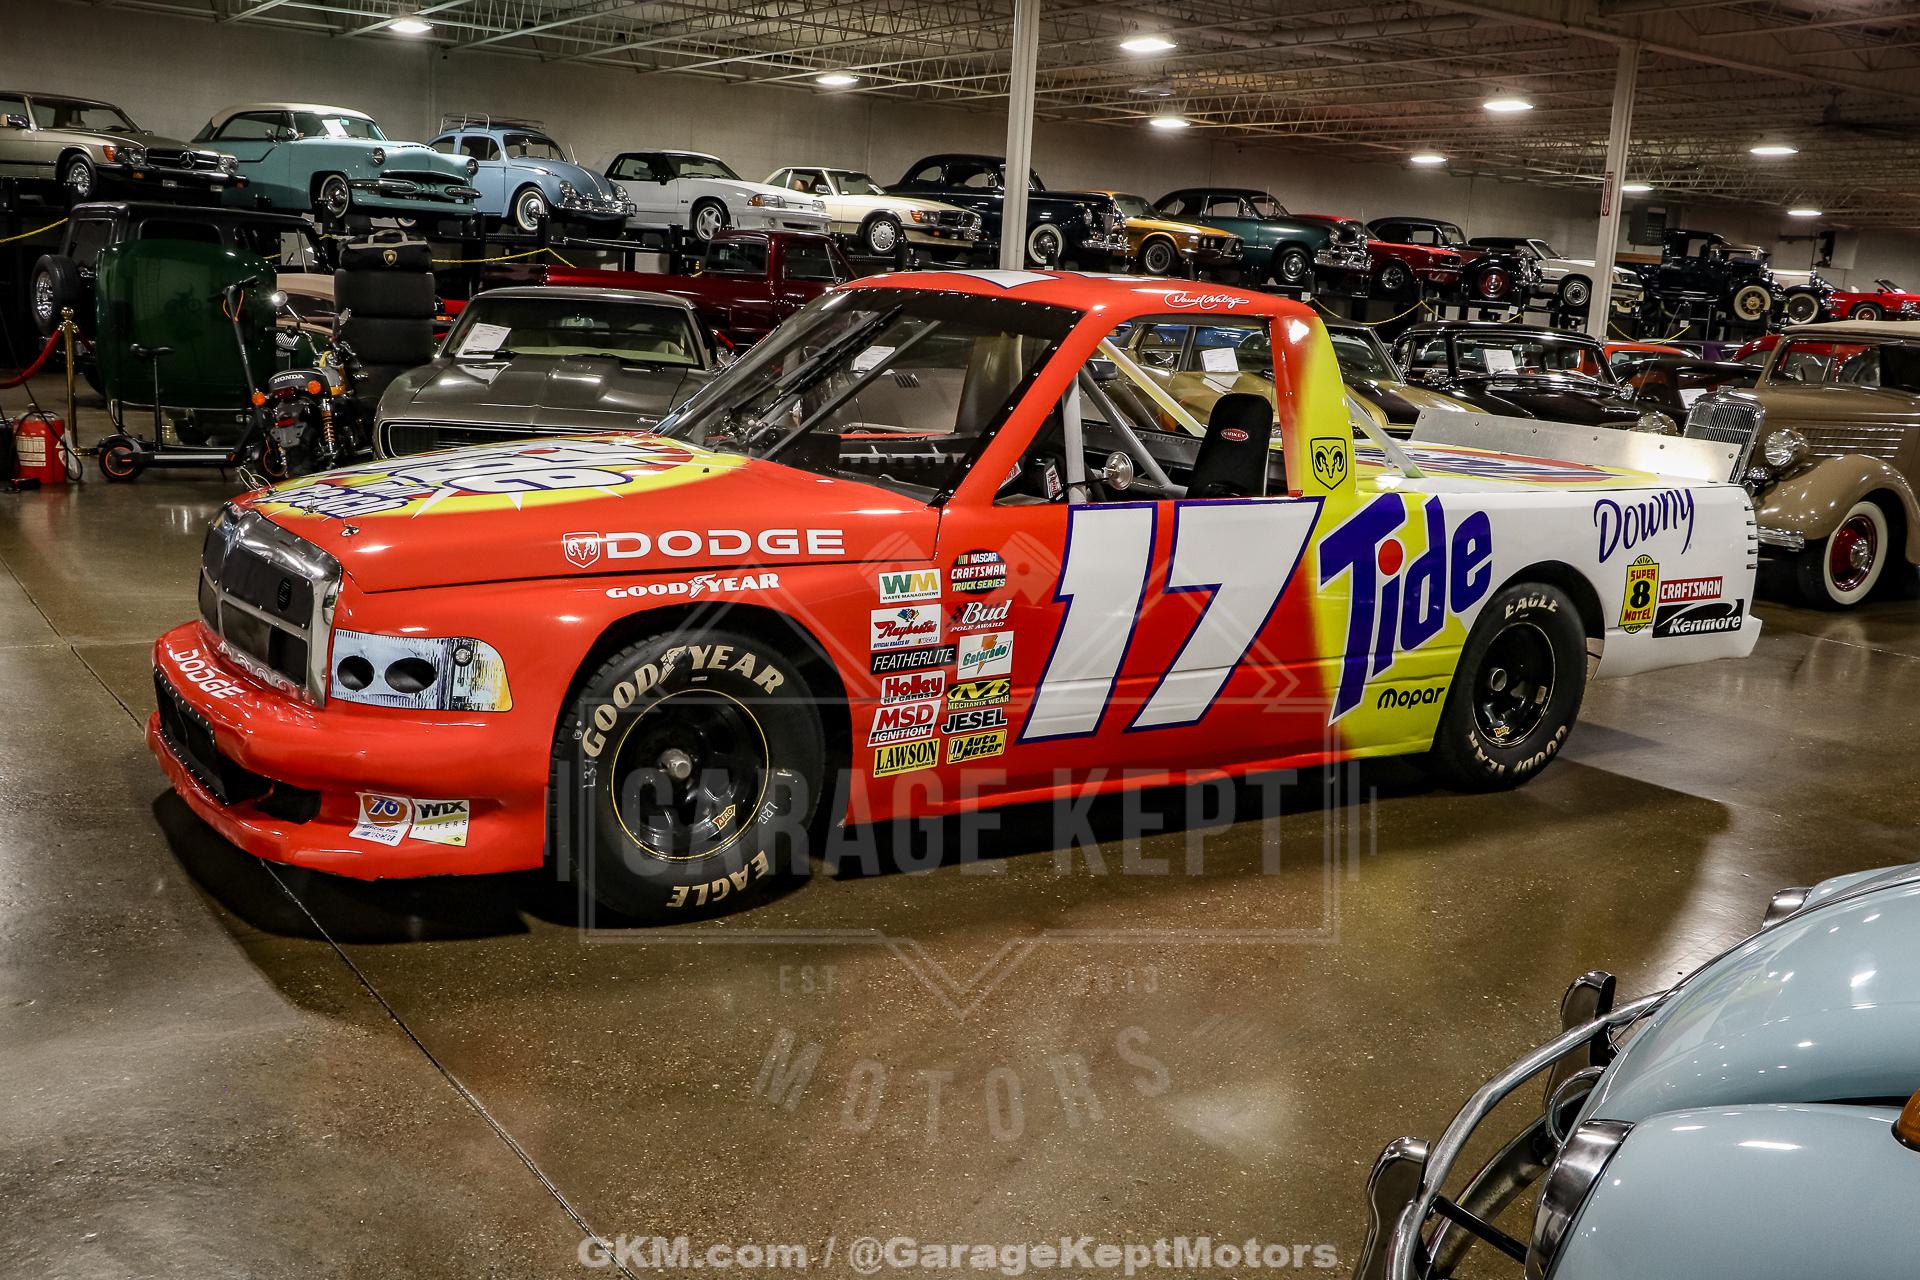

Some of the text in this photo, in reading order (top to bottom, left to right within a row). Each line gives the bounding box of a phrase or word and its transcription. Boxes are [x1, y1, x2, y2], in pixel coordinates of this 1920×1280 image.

[274, 374, 305, 384] HONDA
[1593, 488, 1695, 563] Downy
[604, 528, 846, 560] DODGE
[970, 552, 997, 564] NASCAR
[951, 564, 1007, 580] CRAFTSMAN
[1630, 568, 1656, 582] SUPER
[881, 572, 938, 595] WM
[951, 578, 1006, 592] TRUCK SERIES
[1661, 580, 1721, 600] CRAFTSMAN
[901, 591, 939, 599] MANAGEMENT
[1630, 580, 1650, 609] 8
[961, 599, 1013, 625] Bud
[1317, 492, 1494, 727] Tide
[1504, 594, 1560, 620] EAGLE
[1624, 608, 1651, 621] MOTEL
[950, 621, 1005, 633] POLE AWARD
[1014, 496, 1325, 746] 17
[1668, 614, 1742, 635] Kenmore
[873, 648, 955, 672] FEATHERLITE
[962, 644, 1008, 667] Gatorade
[172, 648, 247, 699] DODGE
[885, 674, 943, 699] Holley
[947, 694, 1010, 711] MECHANIX WEAR
[1377, 686, 1445, 710] Mopar
[876, 704, 934, 731] MSD
[942, 708, 1007, 733] JESEL
[874, 726, 929, 742] IGNITION
[965, 734, 998, 747] Auto
[876, 740, 938, 771] LAWSON
[961, 743, 1003, 757] Meter
[368, 798, 399, 817] 76
[416, 801, 467, 819] WIX
[718, 808, 733, 825] AERO
[414, 820, 467, 831] FILTERS
[666, 849, 770, 908] EAGLE
